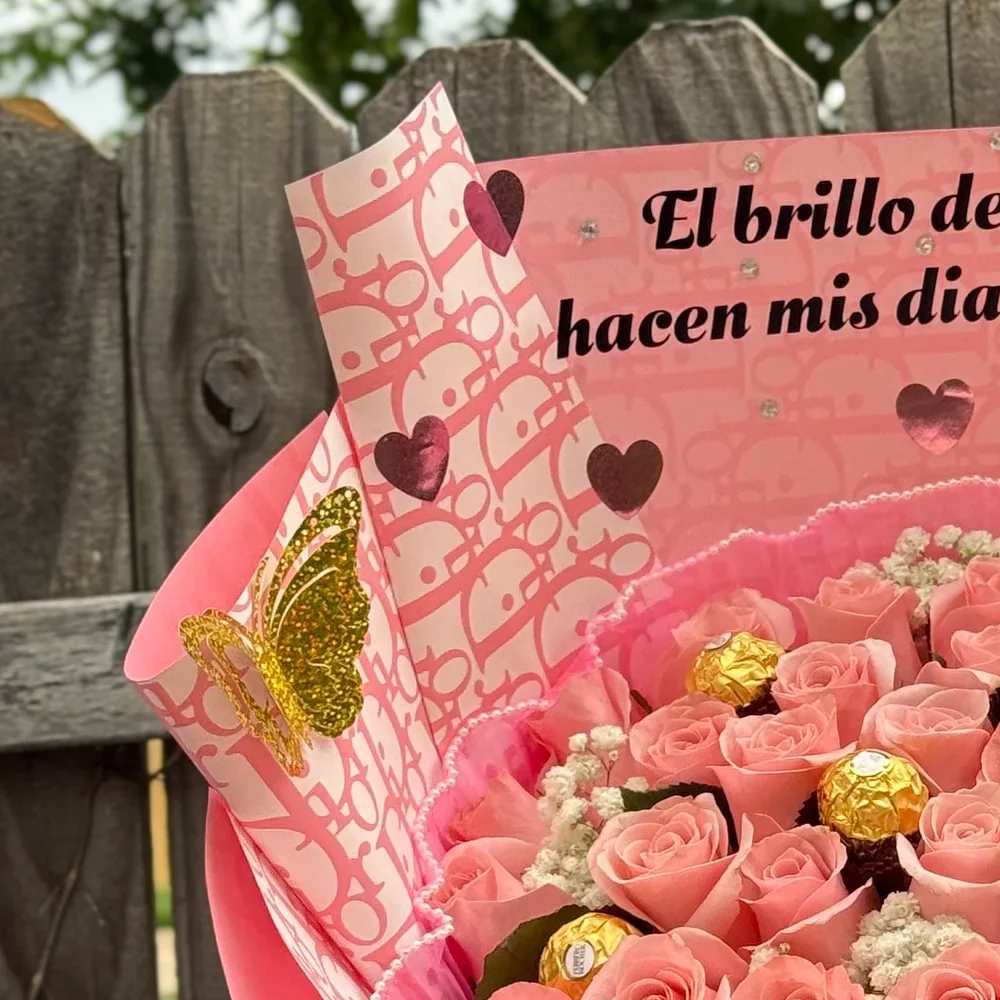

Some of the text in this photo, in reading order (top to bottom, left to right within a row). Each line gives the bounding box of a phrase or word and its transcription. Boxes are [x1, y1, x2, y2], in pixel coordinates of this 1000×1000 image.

[641, 186, 718, 251] El
[733, 176, 916, 245] brillo
[556, 297, 749, 360] hacen
[766, 271, 880, 336] mis
